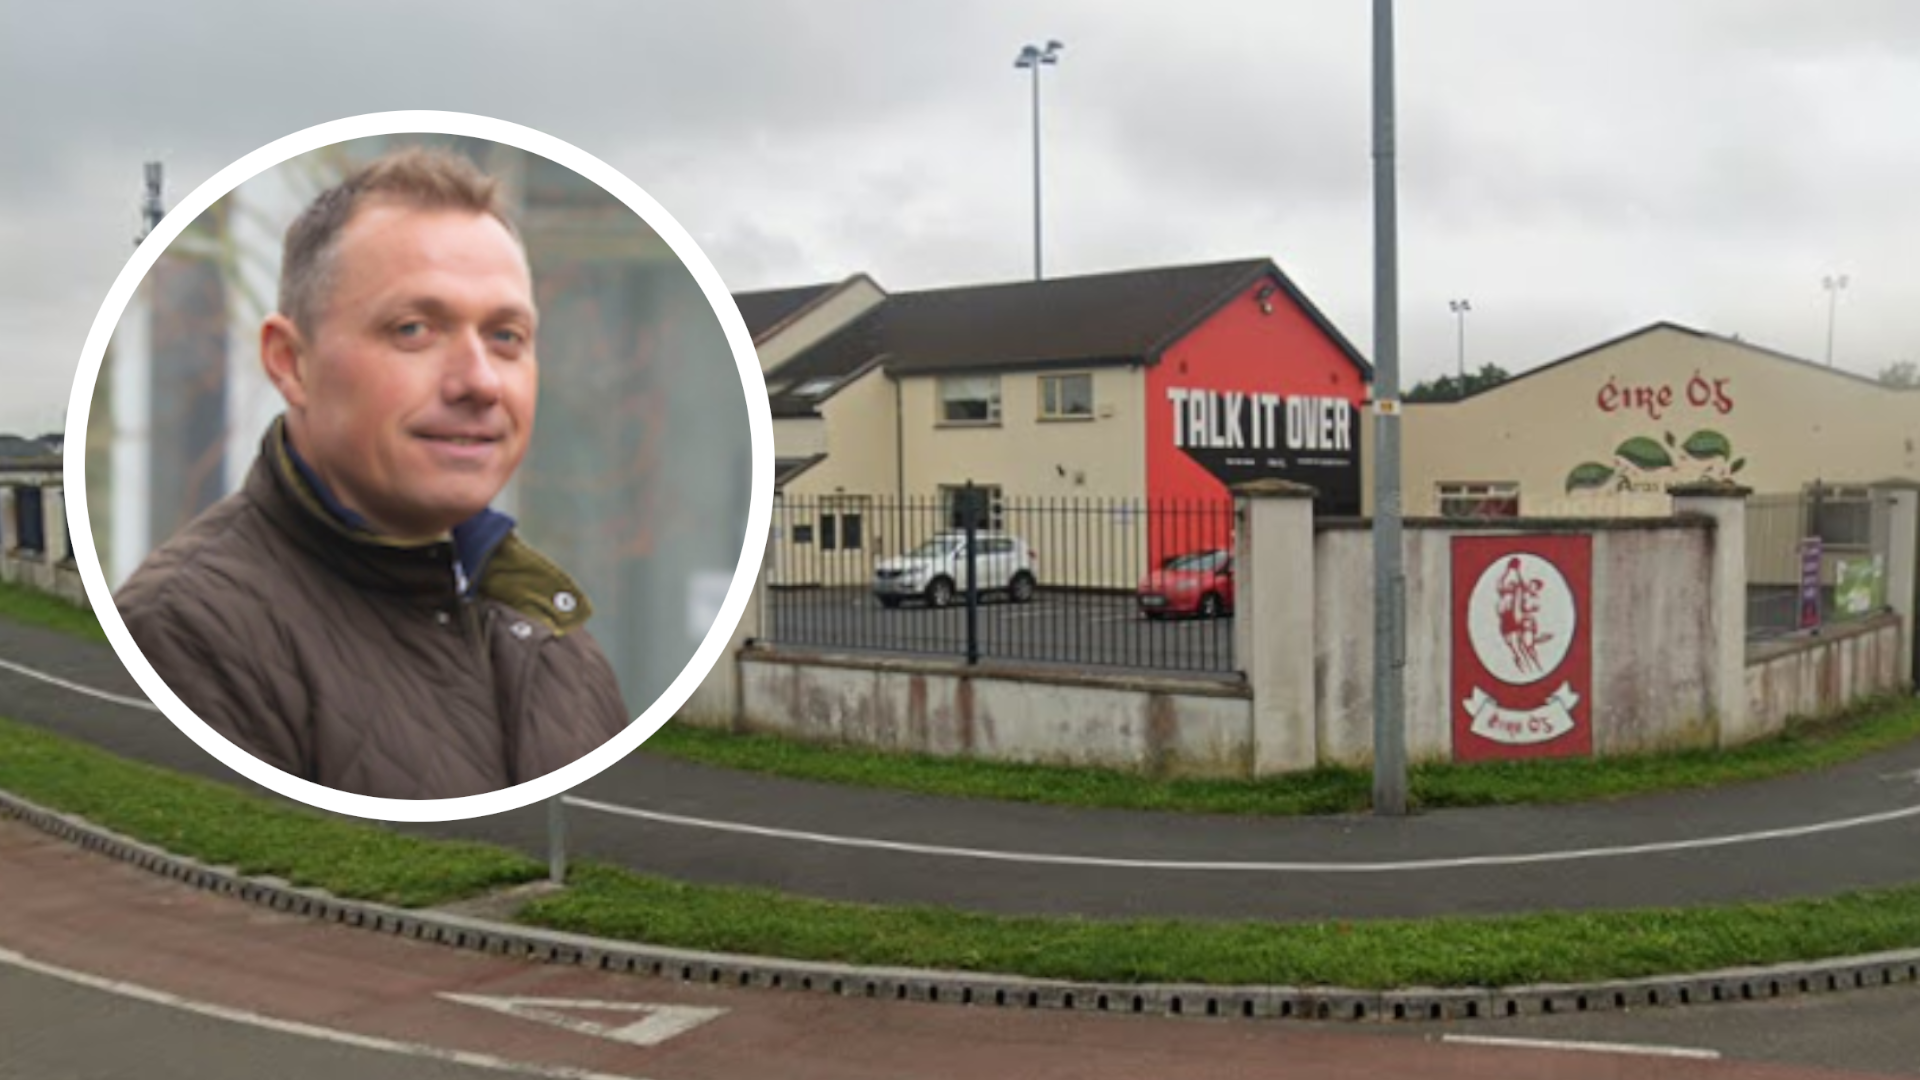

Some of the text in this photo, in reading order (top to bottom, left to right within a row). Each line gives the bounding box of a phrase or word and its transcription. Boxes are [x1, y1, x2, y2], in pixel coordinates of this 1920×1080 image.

[1167, 387, 1352, 450] TALK IT OVER
